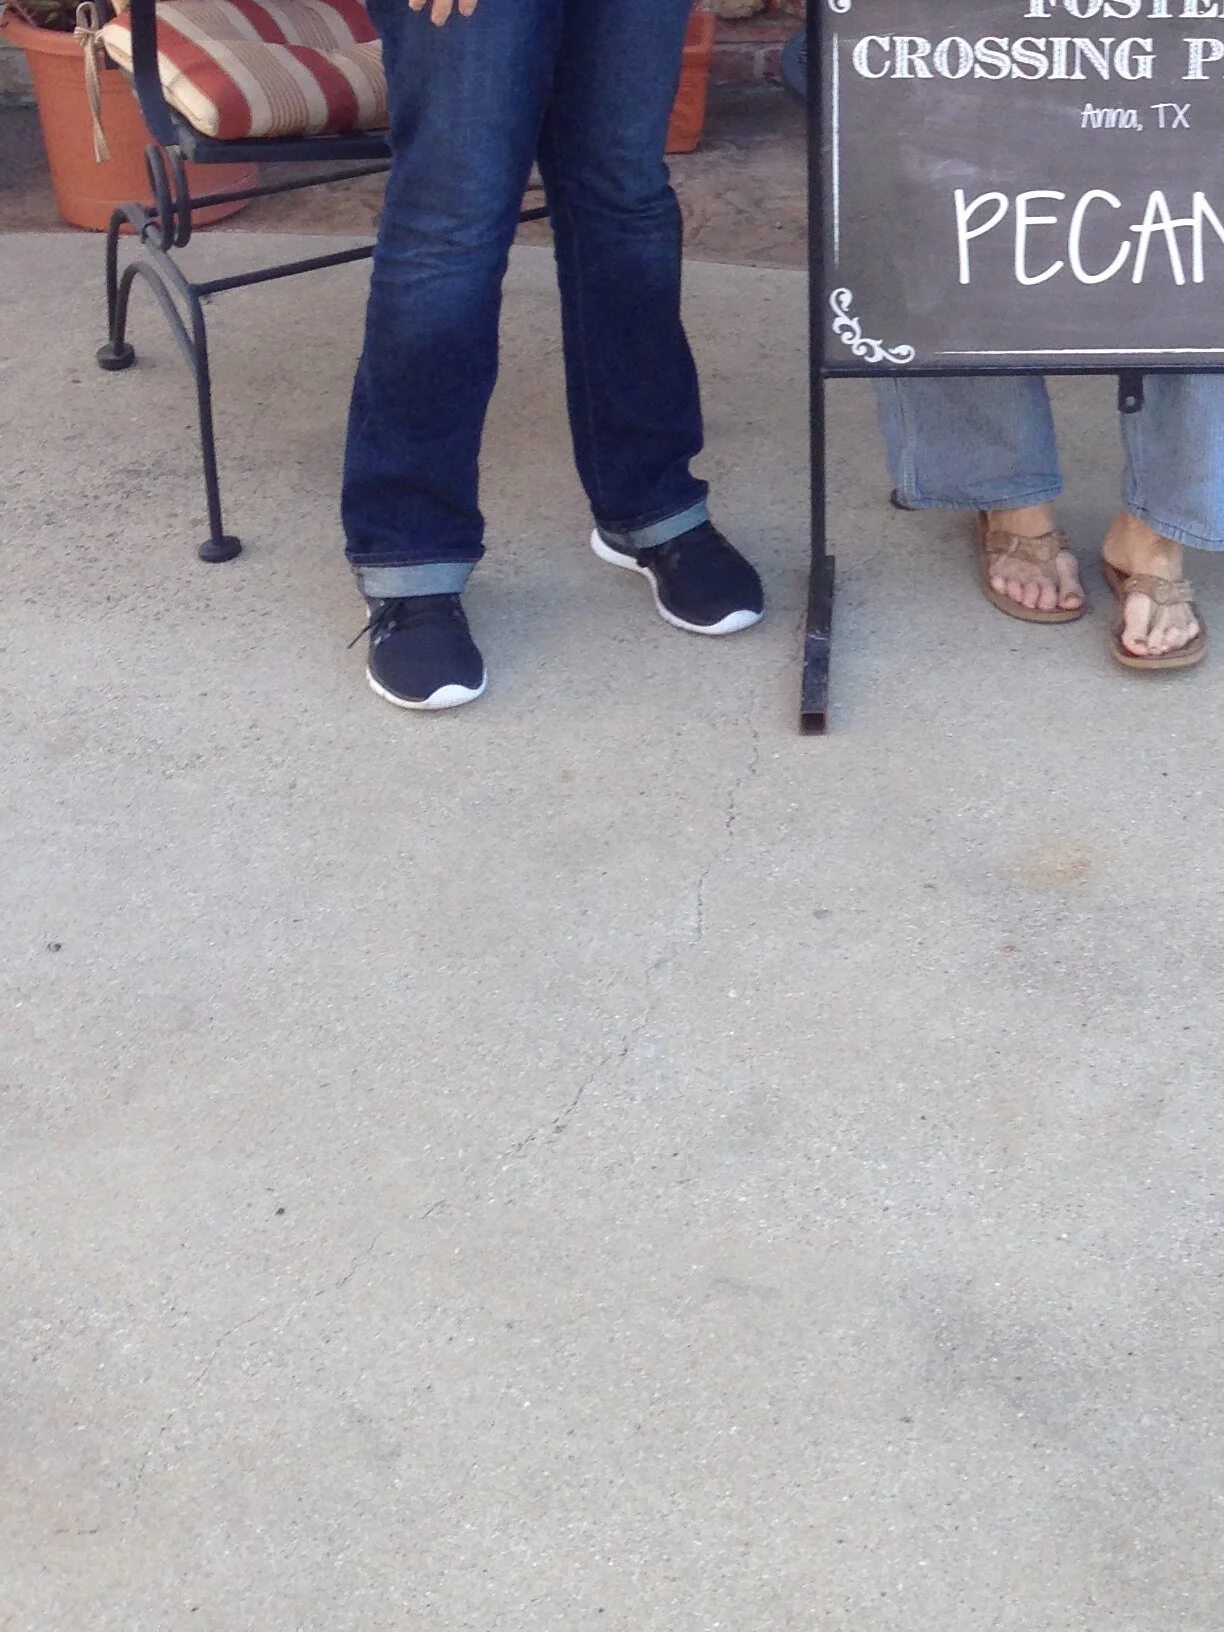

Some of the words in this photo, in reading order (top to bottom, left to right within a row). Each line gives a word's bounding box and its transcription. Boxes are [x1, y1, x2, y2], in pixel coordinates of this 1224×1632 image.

[851, 35, 1157, 81] CROSSING
[1080, 103, 1144, 132] Anna,
[1150, 103, 1192, 129] TX
